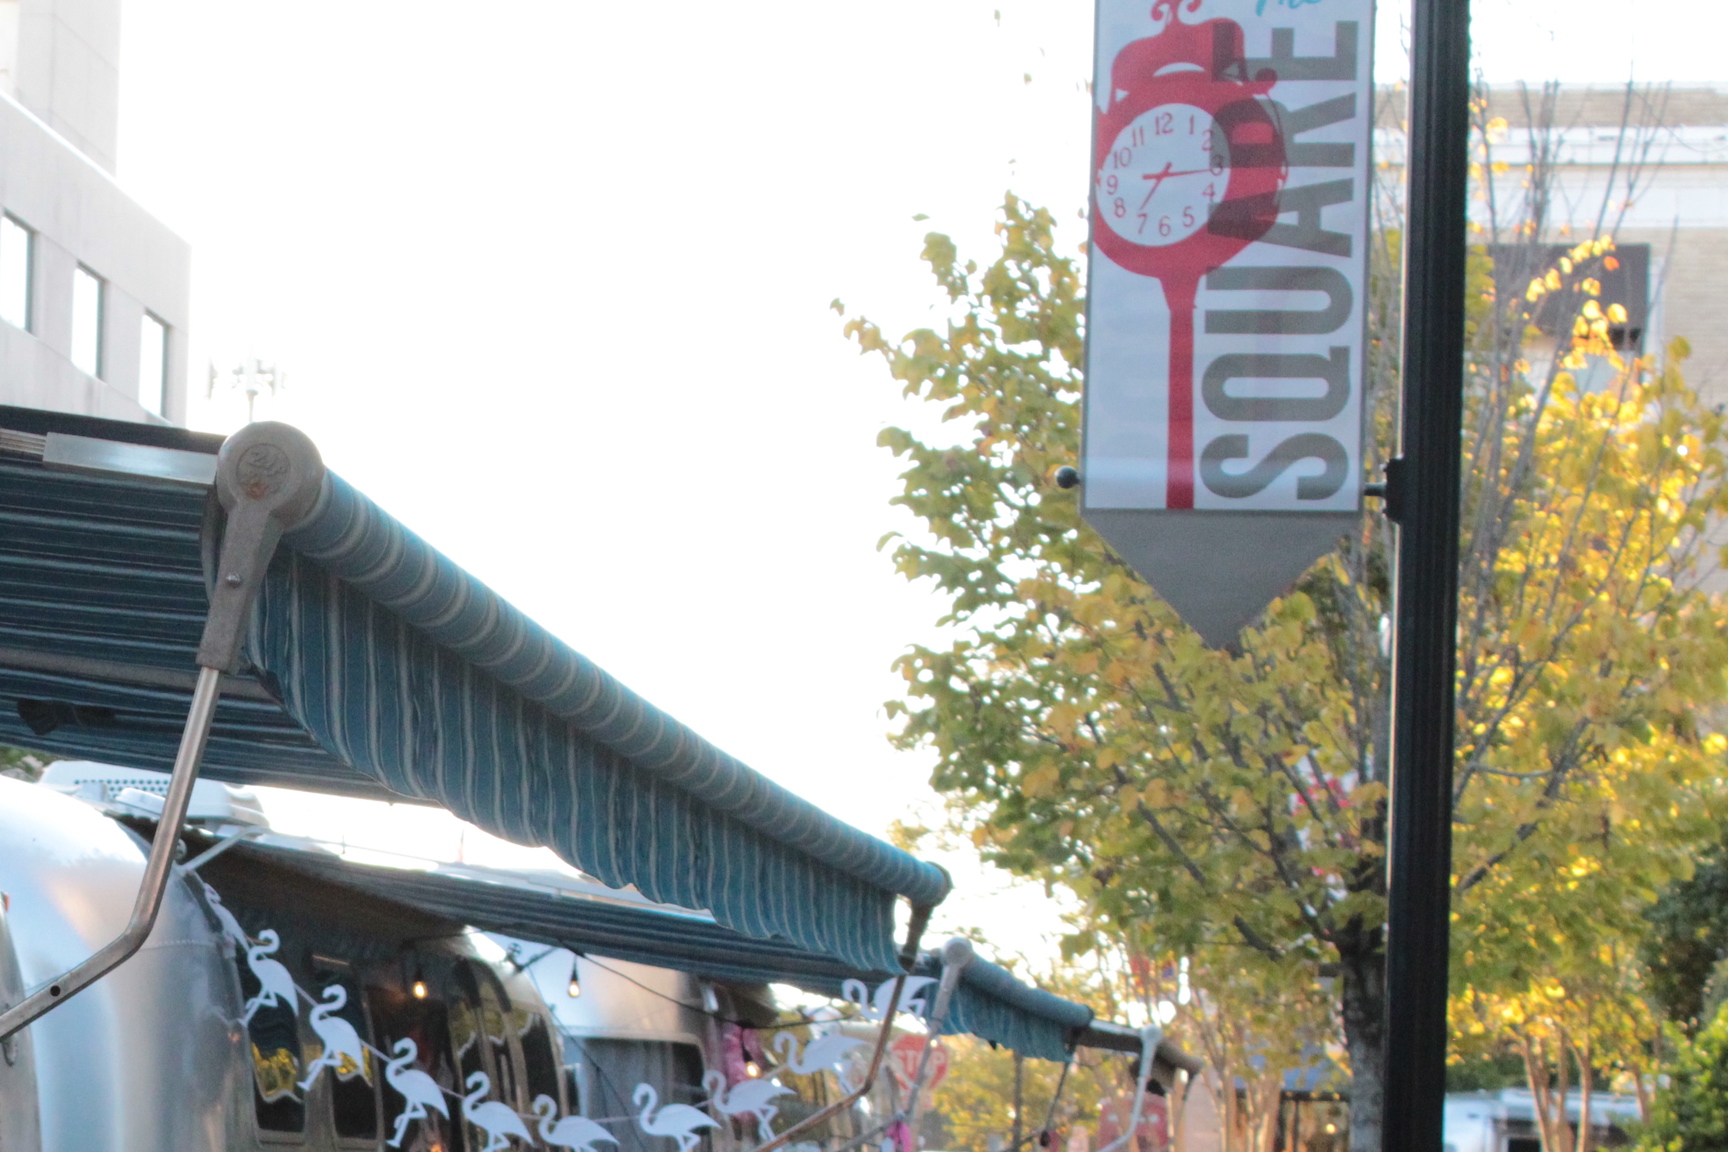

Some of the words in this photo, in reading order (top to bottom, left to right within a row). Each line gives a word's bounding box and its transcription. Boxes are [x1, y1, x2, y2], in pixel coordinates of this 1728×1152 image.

[1154, 112, 1174, 136] 12
[1131, 125, 1145, 148] 11
[1113, 147, 1132, 170] 10
[1106, 174, 1119, 196] 9
[1113, 197, 1127, 219] 8
[1182, 205, 1196, 228] 5
[1136, 212, 1149, 235] 7
[1157, 215, 1172, 237] 6
[1198, 20, 1359, 500] SQUARE
